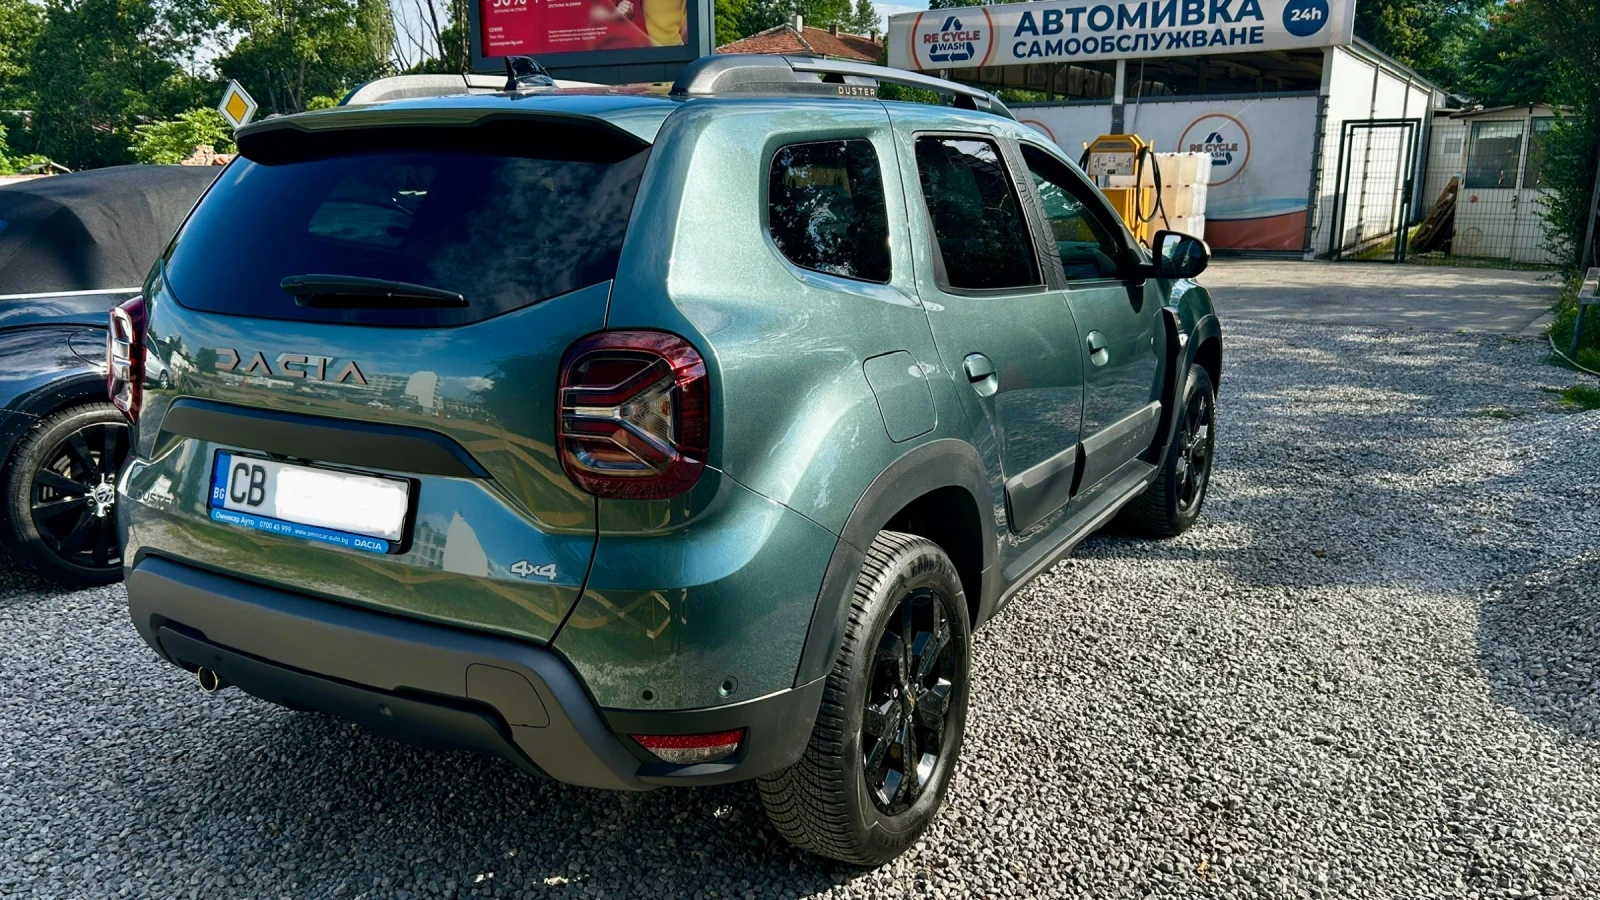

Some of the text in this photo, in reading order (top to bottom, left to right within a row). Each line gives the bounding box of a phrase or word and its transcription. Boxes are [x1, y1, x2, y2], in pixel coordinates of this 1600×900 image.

[1014, 0, 1264, 37] АВТОМИВКА
[1290, 6, 1322, 22] 24h
[923, 30, 980, 44] RE CYCLE
[1012, 26, 1265, 59] САМООБСЛУЖВАНЕ
[938, 42, 965, 51] WASH
[838, 86, 875, 96] DUSTER
[1190, 143, 1238, 153] RE CYCLE
[214, 347, 368, 385] DACIA
[213, 487, 226, 499] BG
[215, 511, 240, 523] Омникар
[241, 516, 255, 526] Ауто
[259, 520, 273, 529] 0700
[273, 522, 281, 530] 45
[281, 523, 292, 531] 999
[354, 538, 382, 550] DACIA
[510, 560, 557, 580] 4x4
